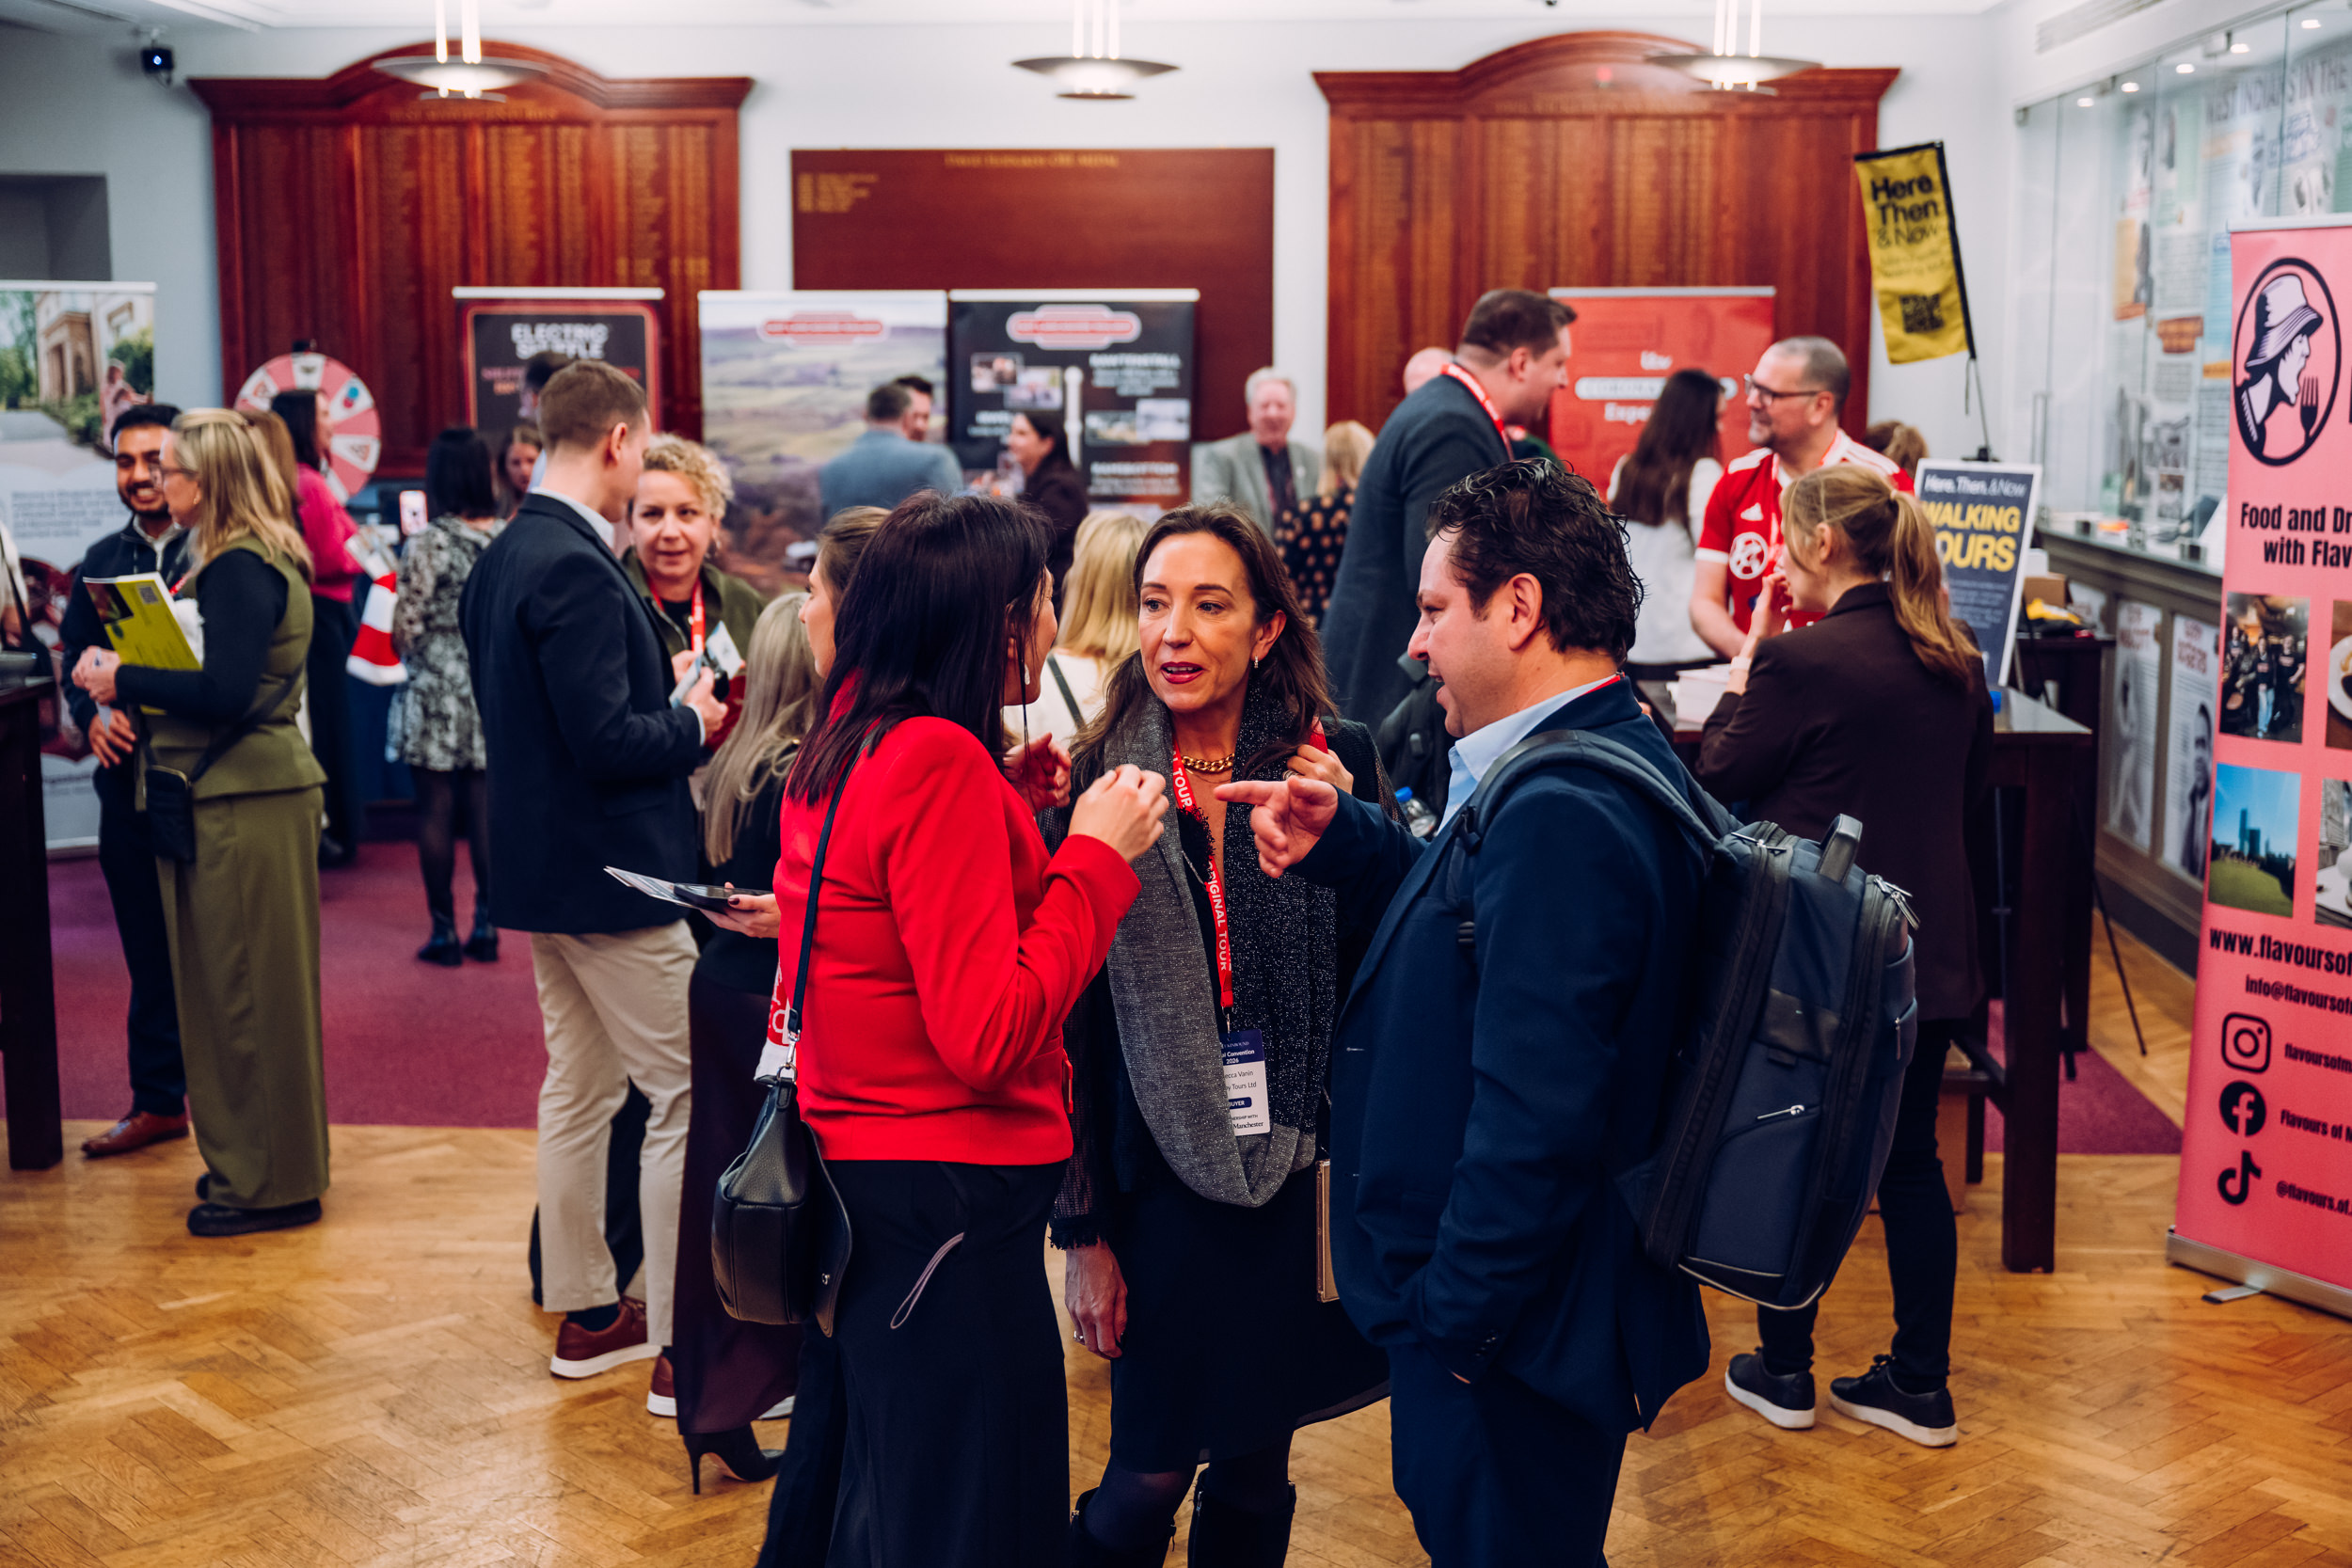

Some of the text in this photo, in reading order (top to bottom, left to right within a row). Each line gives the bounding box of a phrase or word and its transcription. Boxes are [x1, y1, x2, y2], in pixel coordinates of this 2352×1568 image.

[1871, 175, 1934, 201] Here
[1876, 199, 1939, 225] Then
[1895, 225, 1938, 246] Now
[511, 323, 609, 344] ELECTRIC
[1924, 500, 2021, 533] WALKING
[2241, 502, 2282, 530] Food
[2288, 506, 2326, 532] and
[1936, 530, 2016, 572] OURS
[2264, 537, 2306, 565] with
[1173, 768, 1193, 808] TOUR
[1227, 1049, 1255, 1057] Convention
[1233, 1121, 1264, 1130] Manchester
[2280, 1109, 2328, 1136] Flavours
[2331, 1125, 2343, 1139] of
